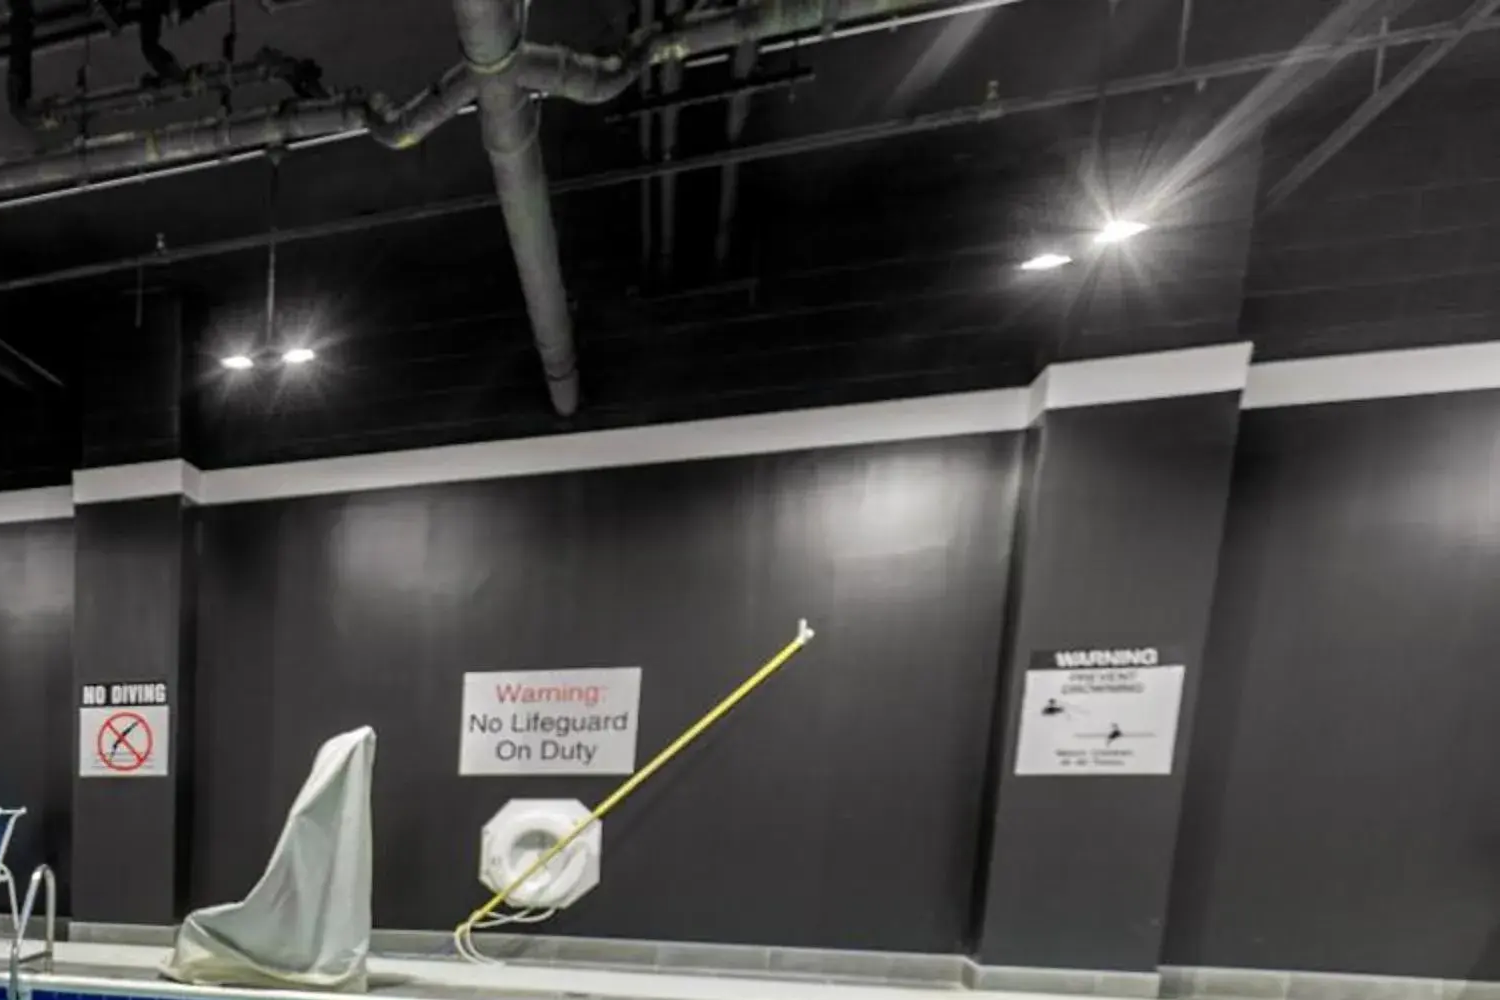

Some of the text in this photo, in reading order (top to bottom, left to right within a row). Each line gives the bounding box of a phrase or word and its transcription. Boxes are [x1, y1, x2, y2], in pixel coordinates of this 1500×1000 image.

[1055, 648, 1159, 667] WARNING
[83, 683, 167, 704] NO DIVING
[468, 712, 628, 737] No Lifeguard
[495, 739, 597, 766] On Duty
